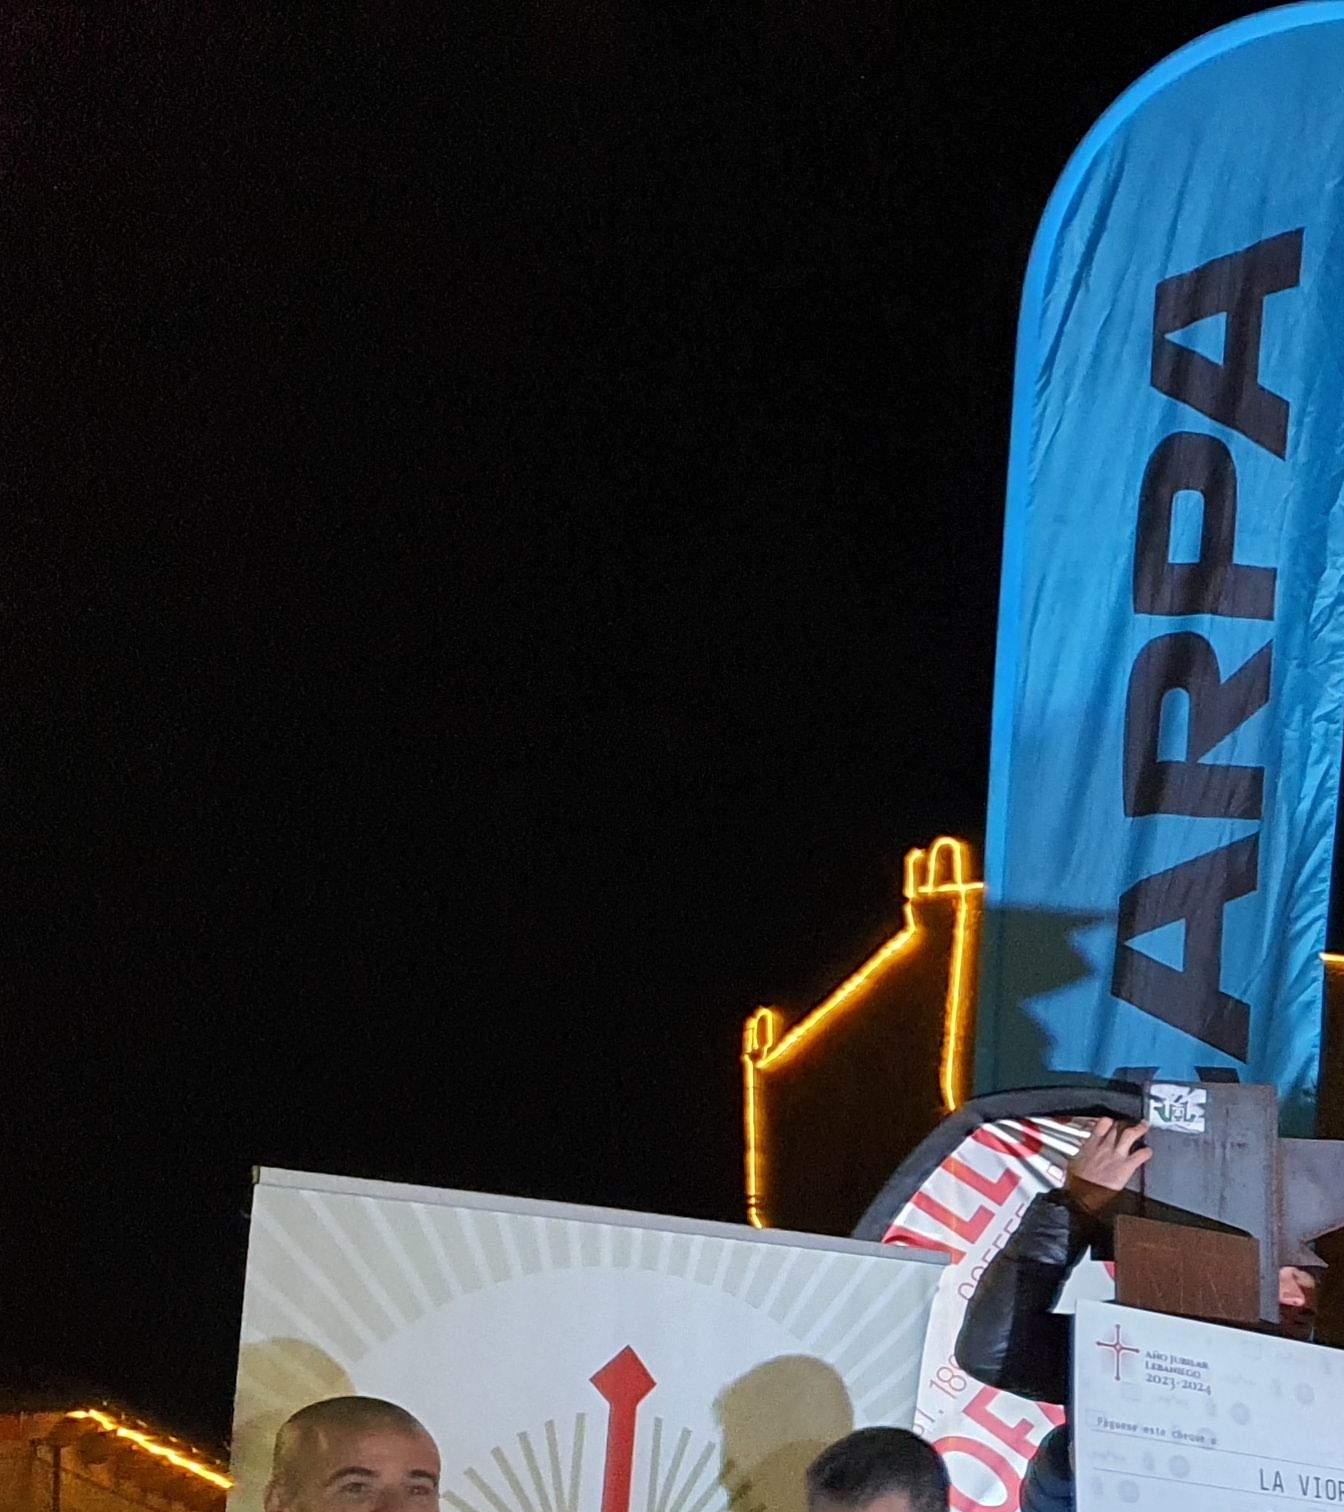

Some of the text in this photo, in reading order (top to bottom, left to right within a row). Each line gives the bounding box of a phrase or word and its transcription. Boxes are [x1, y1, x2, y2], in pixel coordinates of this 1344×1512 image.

[1109, 226, 1305, 1082] ARPA
[1145, 1361, 1201, 1378] LEBANIEGO
[1169, 1355, 1209, 1370] JUBILAR
[1259, 1468, 1284, 1493] LA
